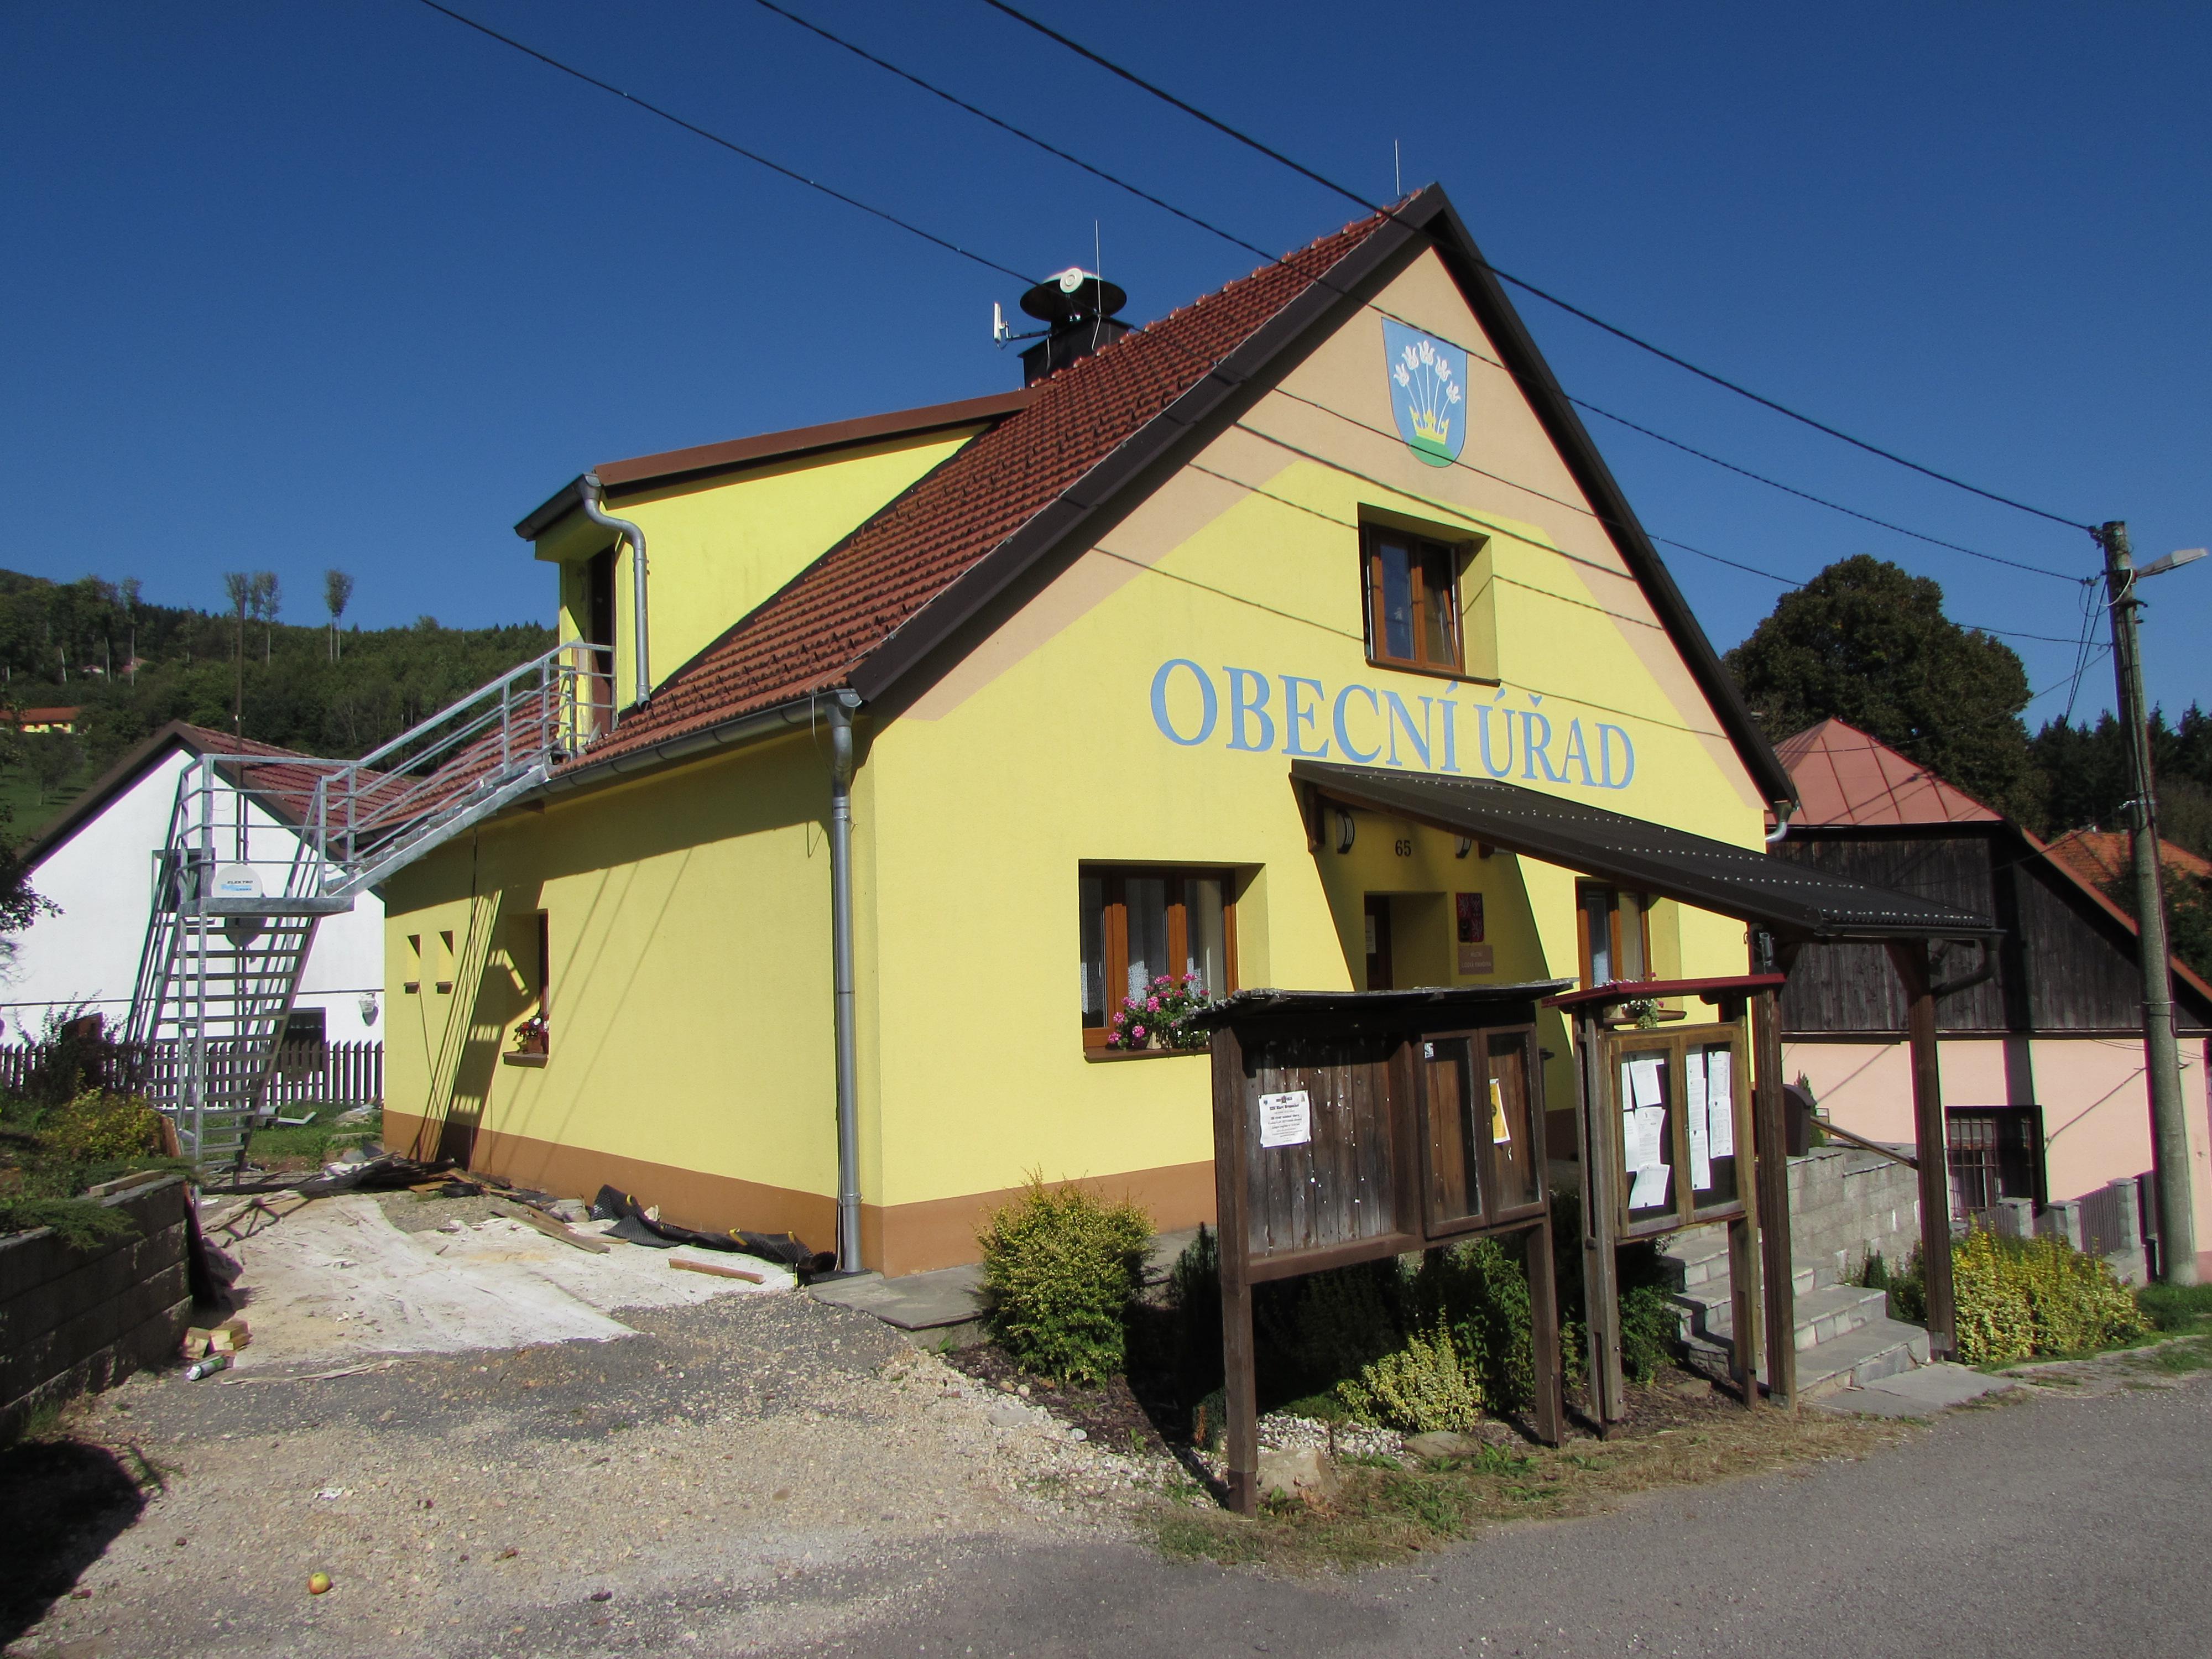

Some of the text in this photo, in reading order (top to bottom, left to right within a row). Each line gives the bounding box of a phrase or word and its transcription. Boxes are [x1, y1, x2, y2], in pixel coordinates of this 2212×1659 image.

[1150, 658, 1635, 790] OBECNÍ ÚŘAD
[1395, 839, 1411, 857] 65
